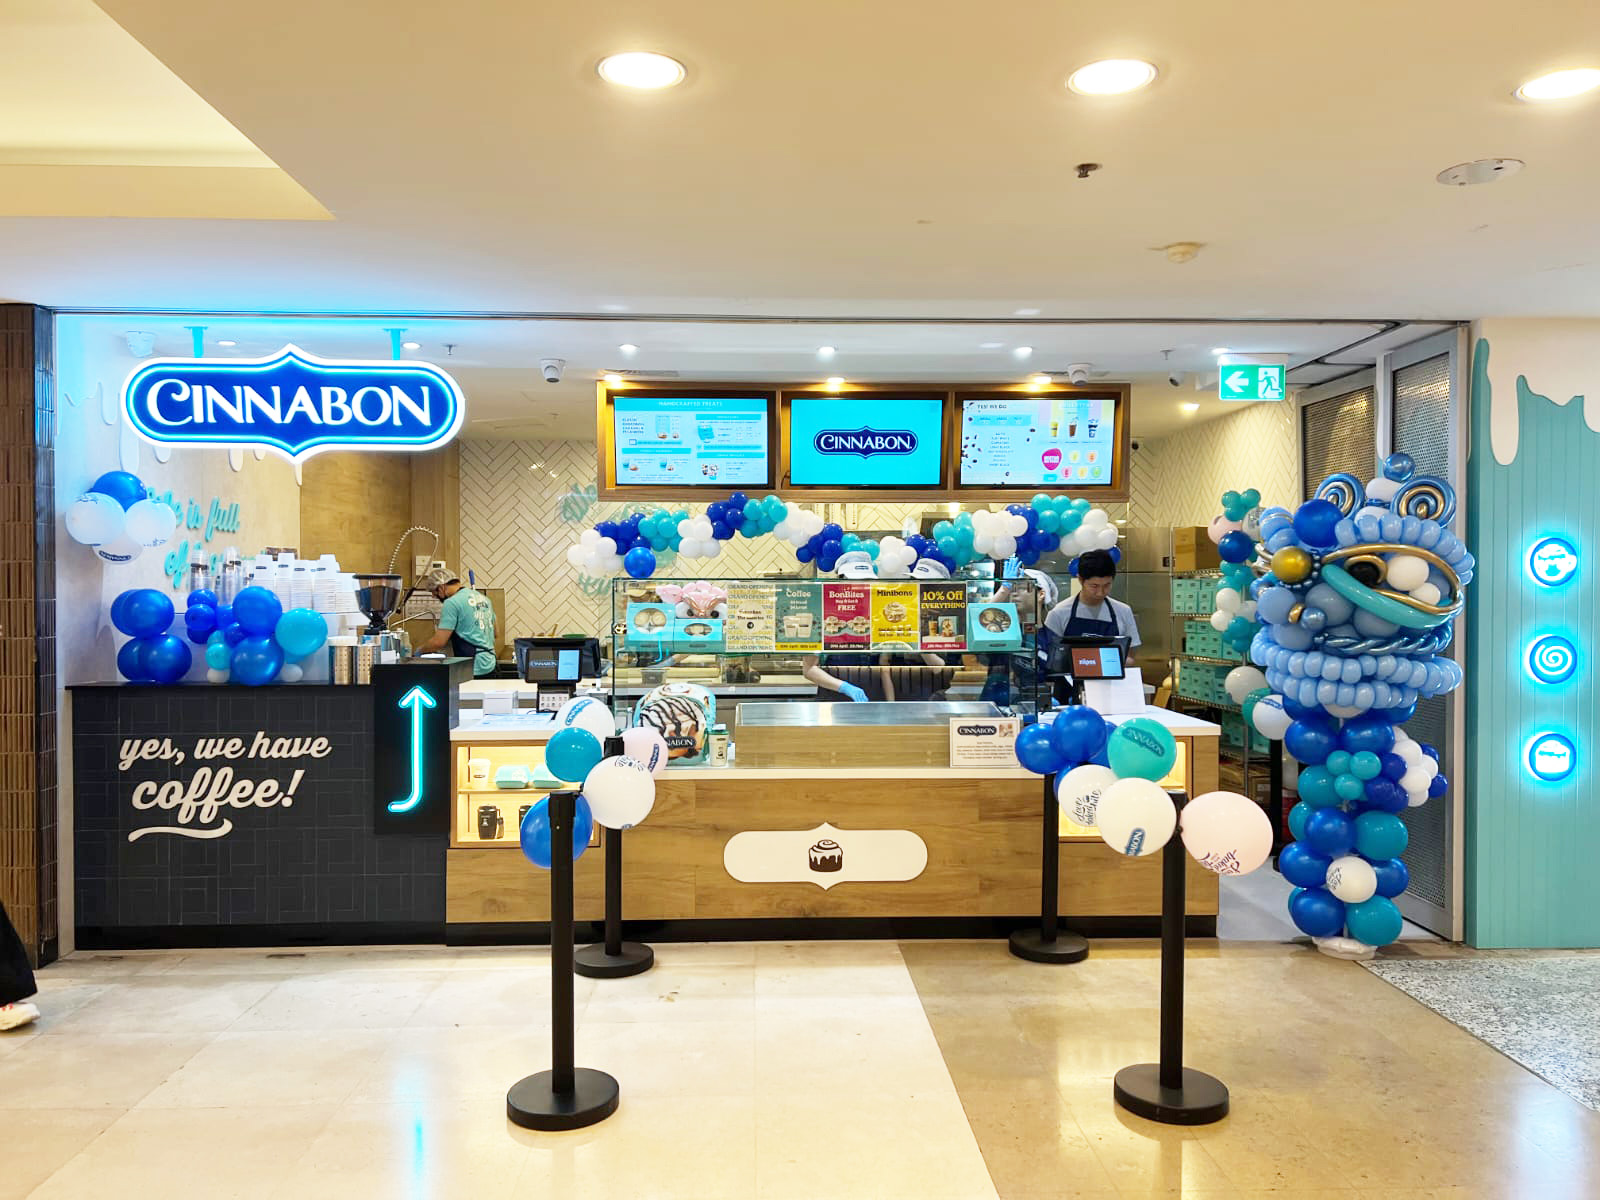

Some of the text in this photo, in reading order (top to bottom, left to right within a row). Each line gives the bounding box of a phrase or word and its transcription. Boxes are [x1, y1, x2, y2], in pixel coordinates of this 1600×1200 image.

[147, 378, 432, 427] CINNABON
[820, 434, 911, 450] CINNABON
[829, 590, 865, 598] BonBites
[923, 590, 964, 601] 10% Off
[118, 731, 332, 771] yes, we have
[131, 766, 305, 824] coffee!
